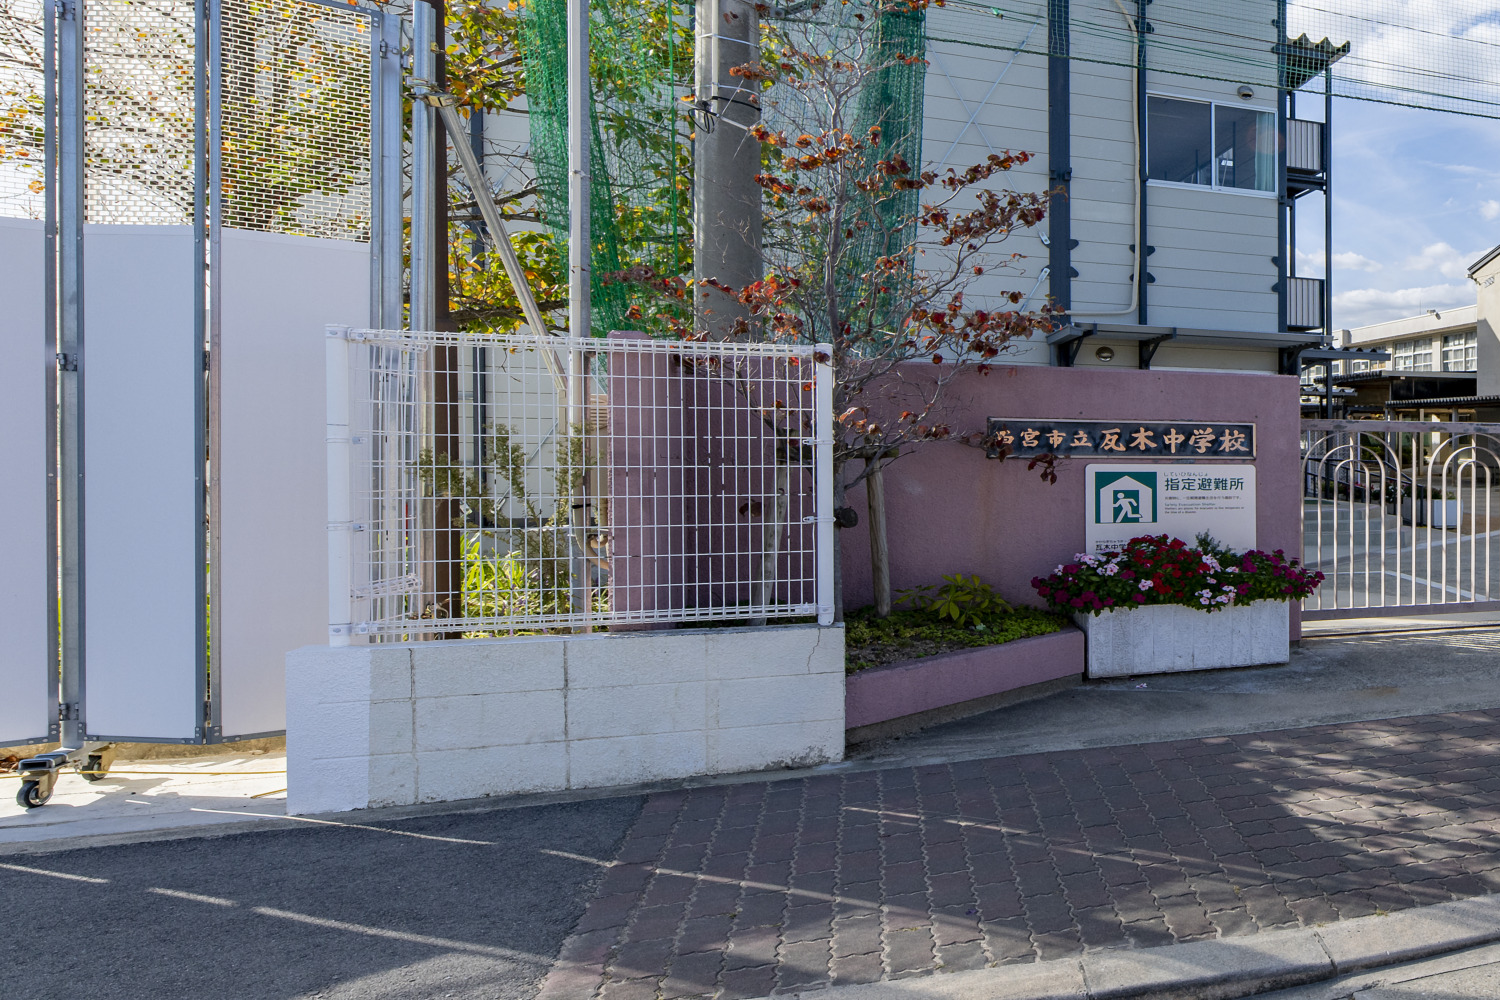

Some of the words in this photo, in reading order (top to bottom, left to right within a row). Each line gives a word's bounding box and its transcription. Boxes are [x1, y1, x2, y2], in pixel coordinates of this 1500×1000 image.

[1164, 477, 1245, 491] 指定避難所
